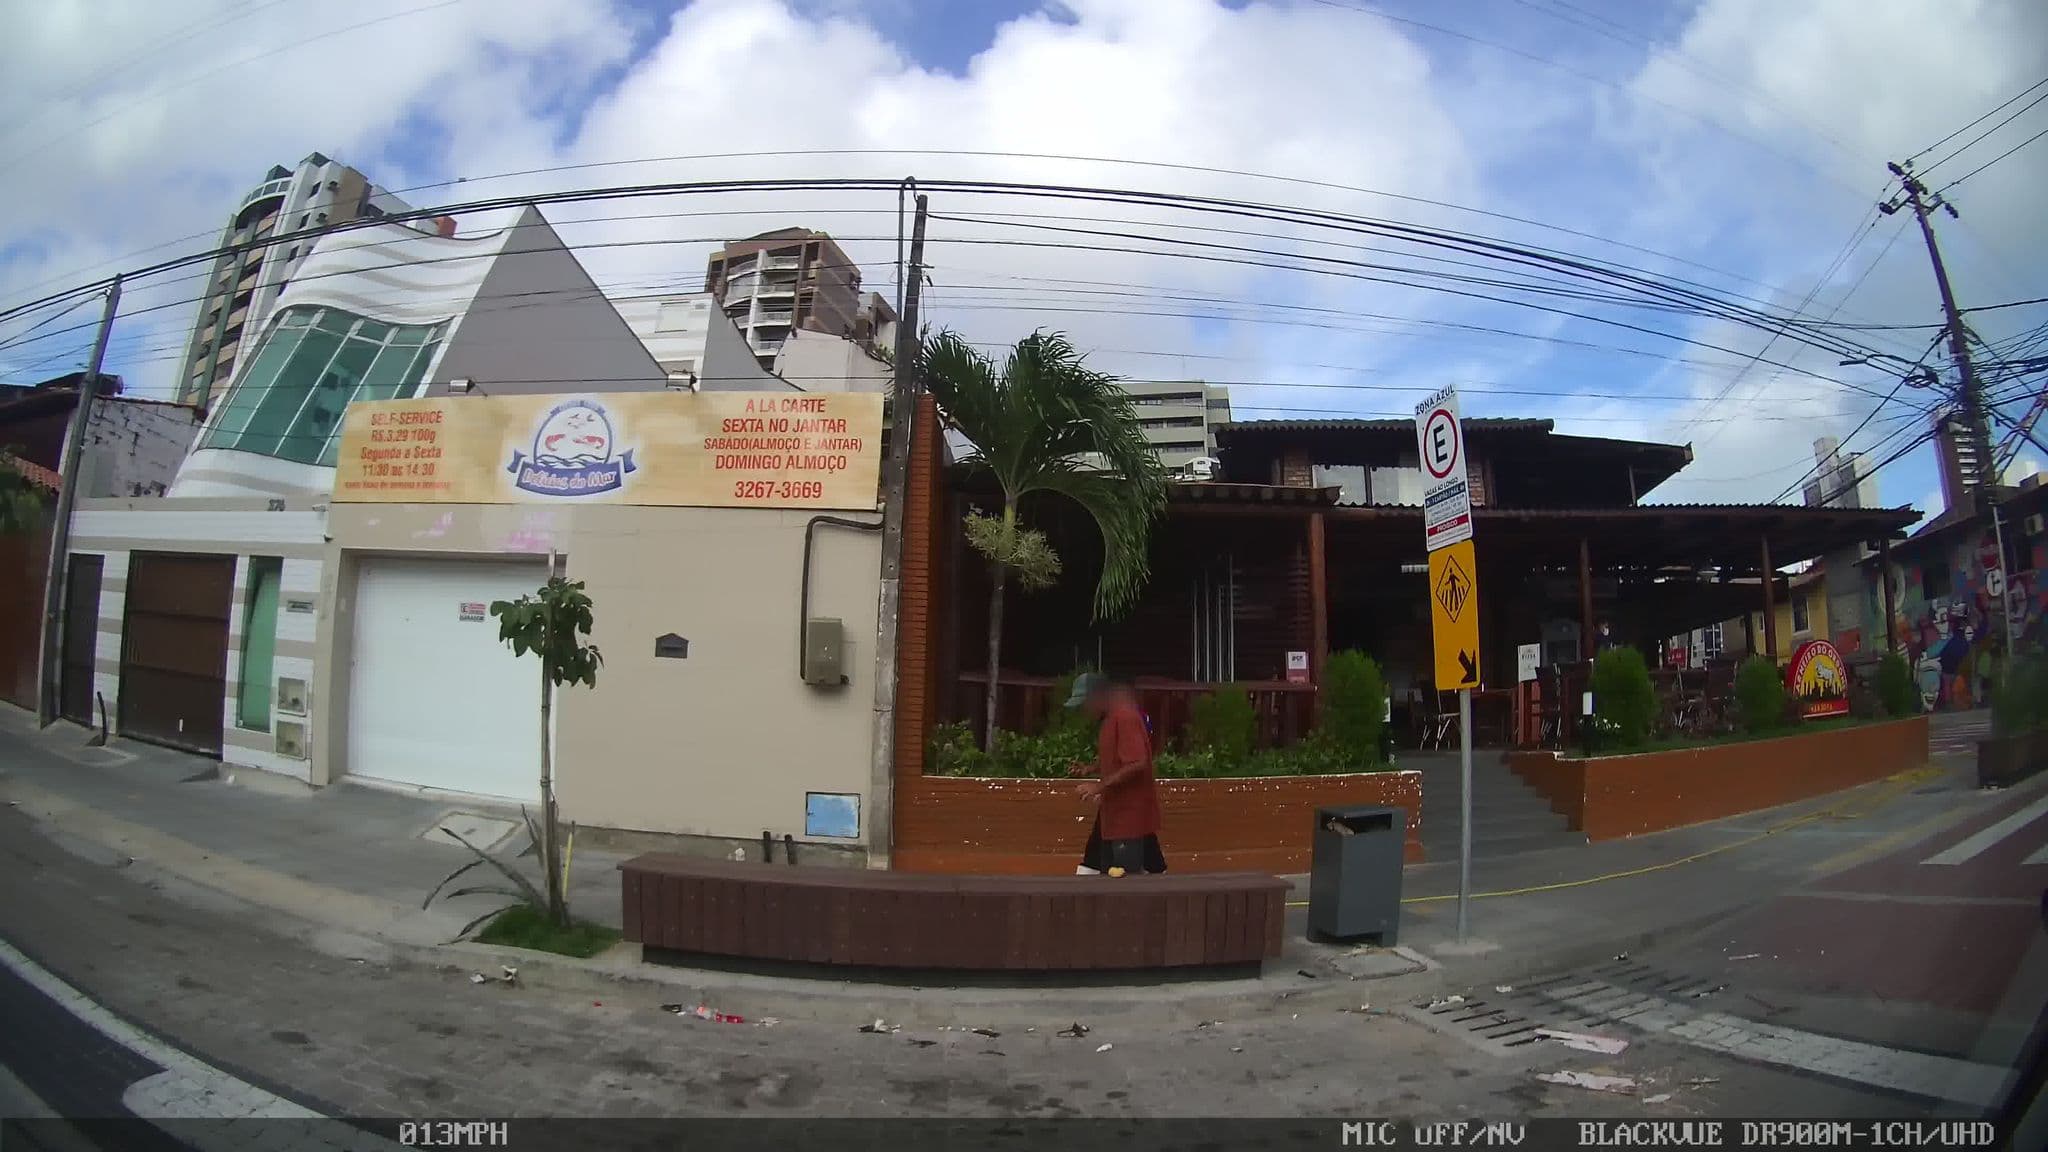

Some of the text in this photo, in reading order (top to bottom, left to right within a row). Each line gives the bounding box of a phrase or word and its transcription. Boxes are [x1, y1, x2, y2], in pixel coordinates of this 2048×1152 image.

[745, 398, 827, 413] A LA CARTE
[1415, 384, 1454, 415] ZONA AZUL
[371, 411, 443, 425] SELF-SERVICE
[722, 418, 846, 433] SEXTA NO JANTAR
[411, 429, 436, 443] 100g
[1433, 423, 1448, 464] E
[361, 445, 441, 461] Segunda a Sexta
[804, 438, 812, 450] E
[815, 438, 863, 452] JANTAR)
[715, 455, 847, 474] DOMINGO ALMOÇO
[587, 471, 617, 487] Mar
[735, 481, 823, 499] 3267-3669
